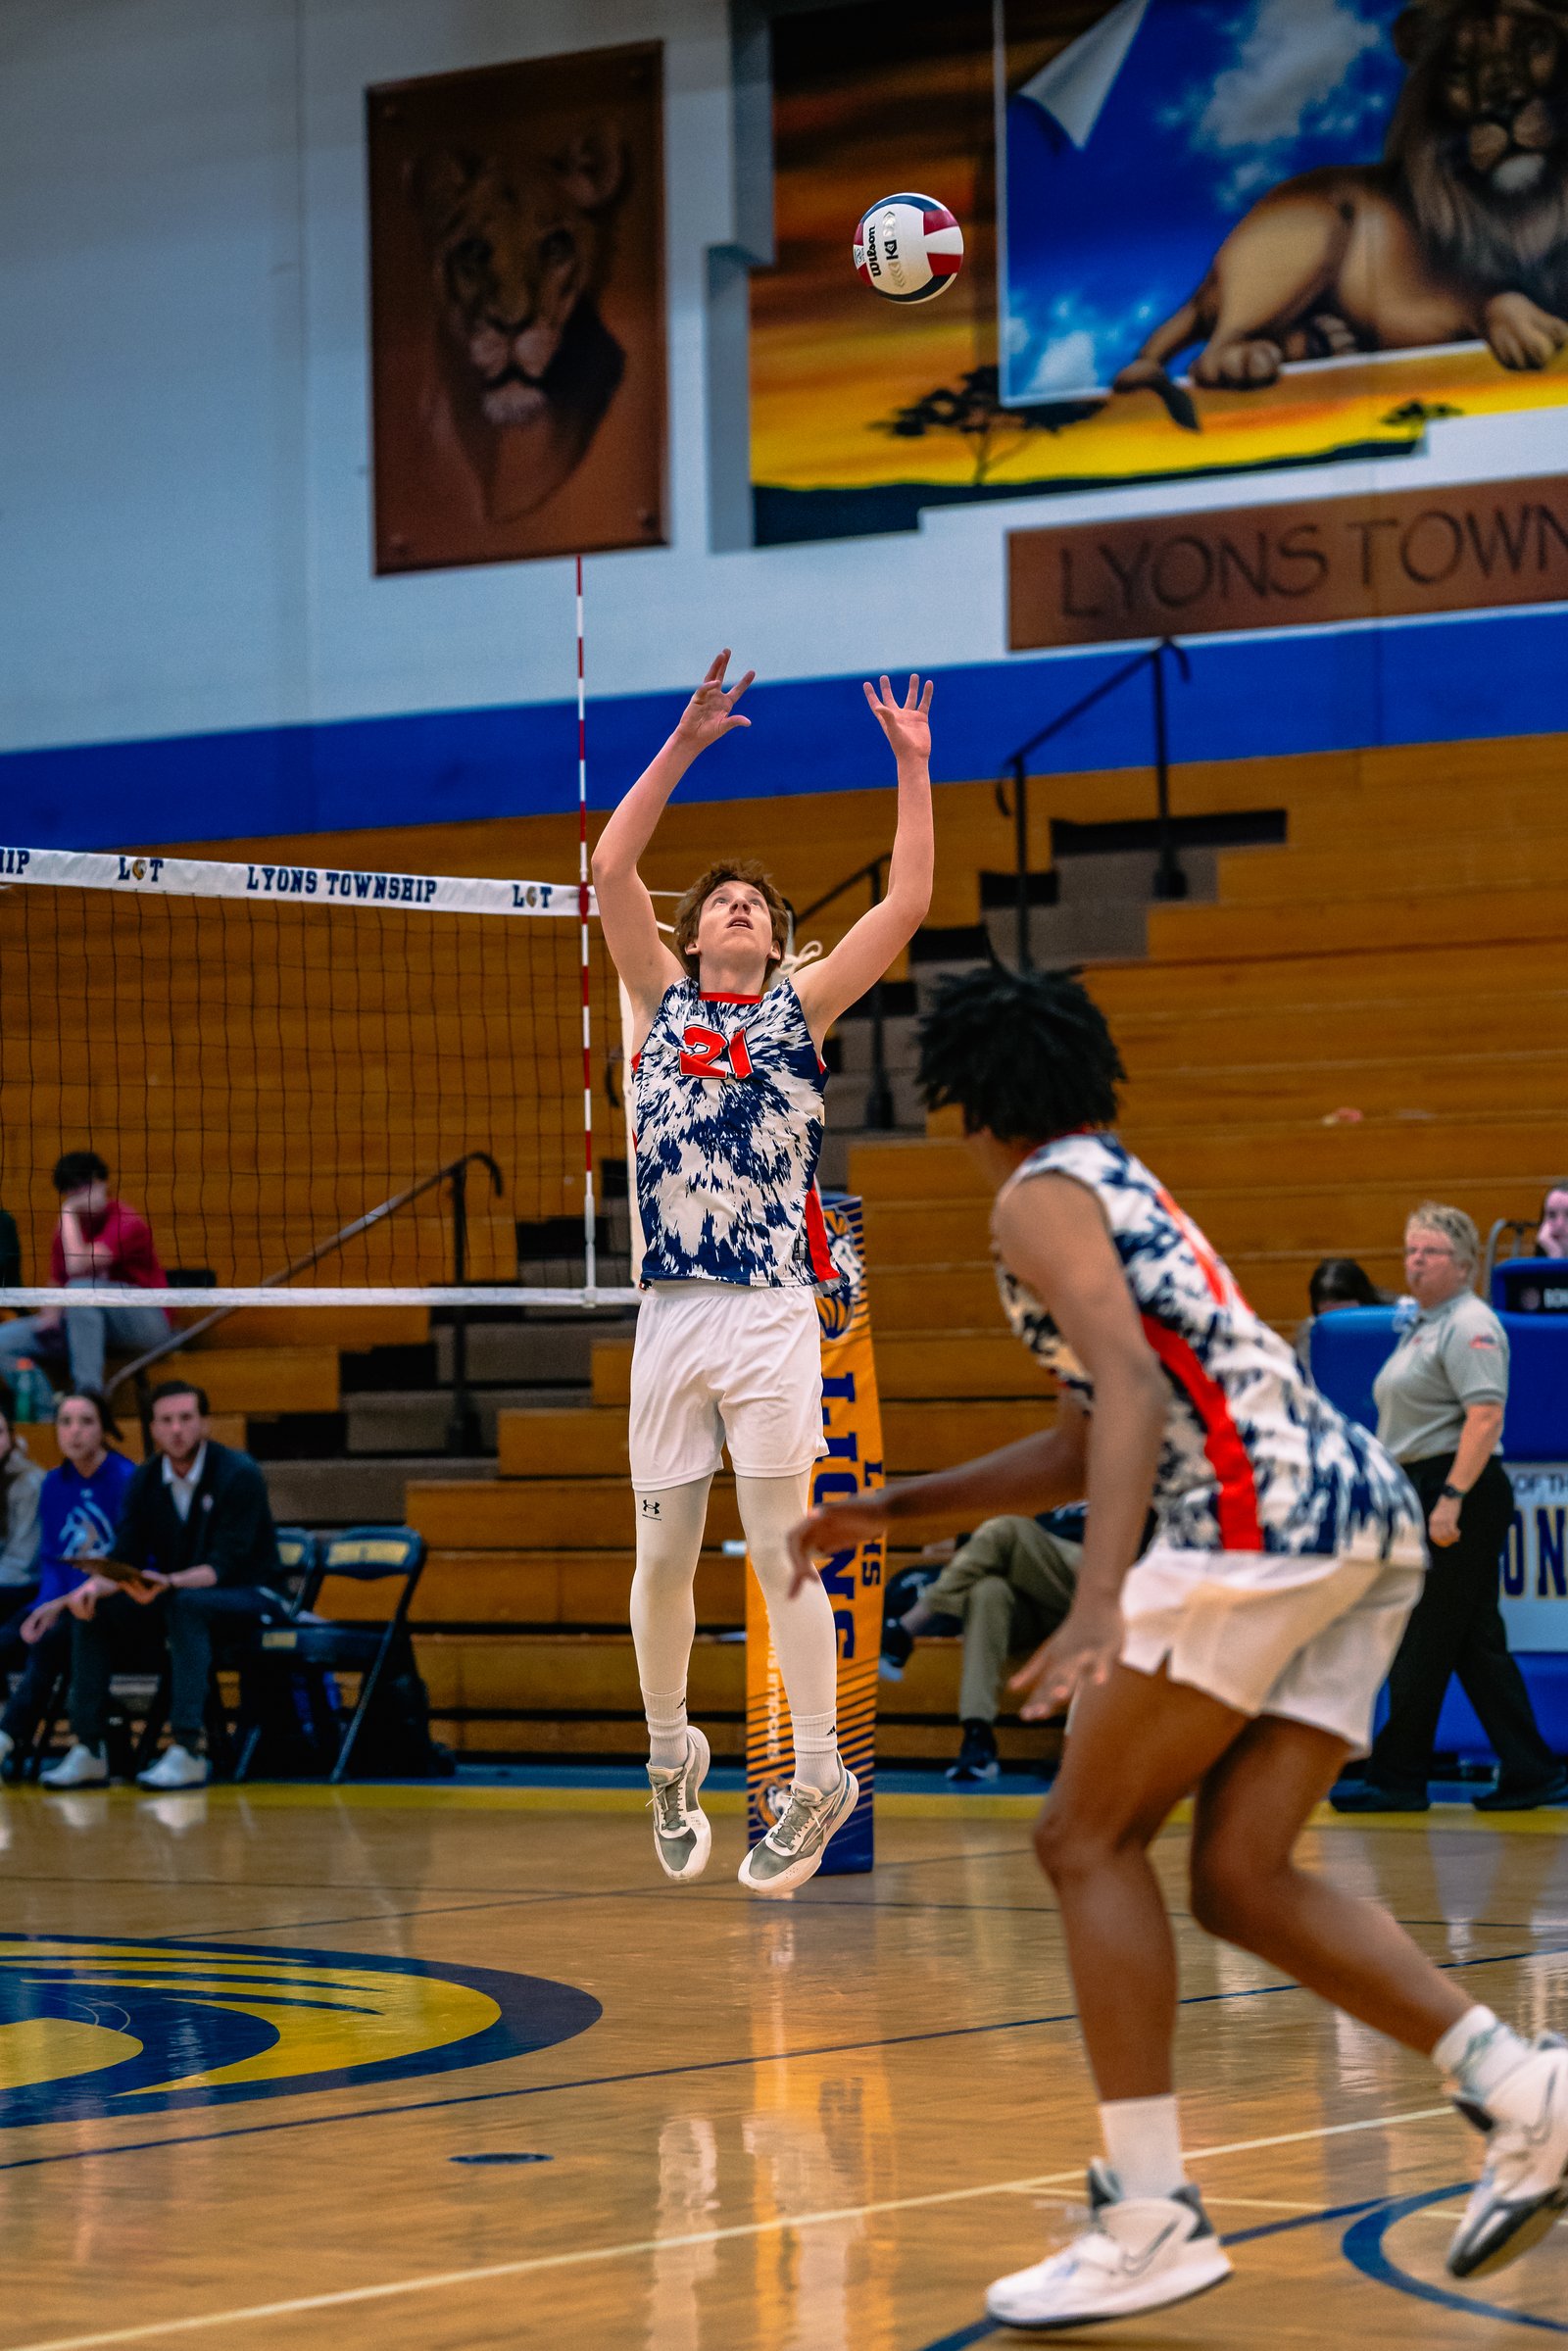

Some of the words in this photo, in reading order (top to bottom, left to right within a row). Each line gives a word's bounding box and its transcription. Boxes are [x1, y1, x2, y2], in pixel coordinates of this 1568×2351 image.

[867, 224, 882, 277] Wilson
[1058, 523, 1329, 619] LYONS
[246, 866, 318, 894] LYONS
[326, 871, 438, 904] TOWNSHIP
[678, 1023, 754, 1080] 21
